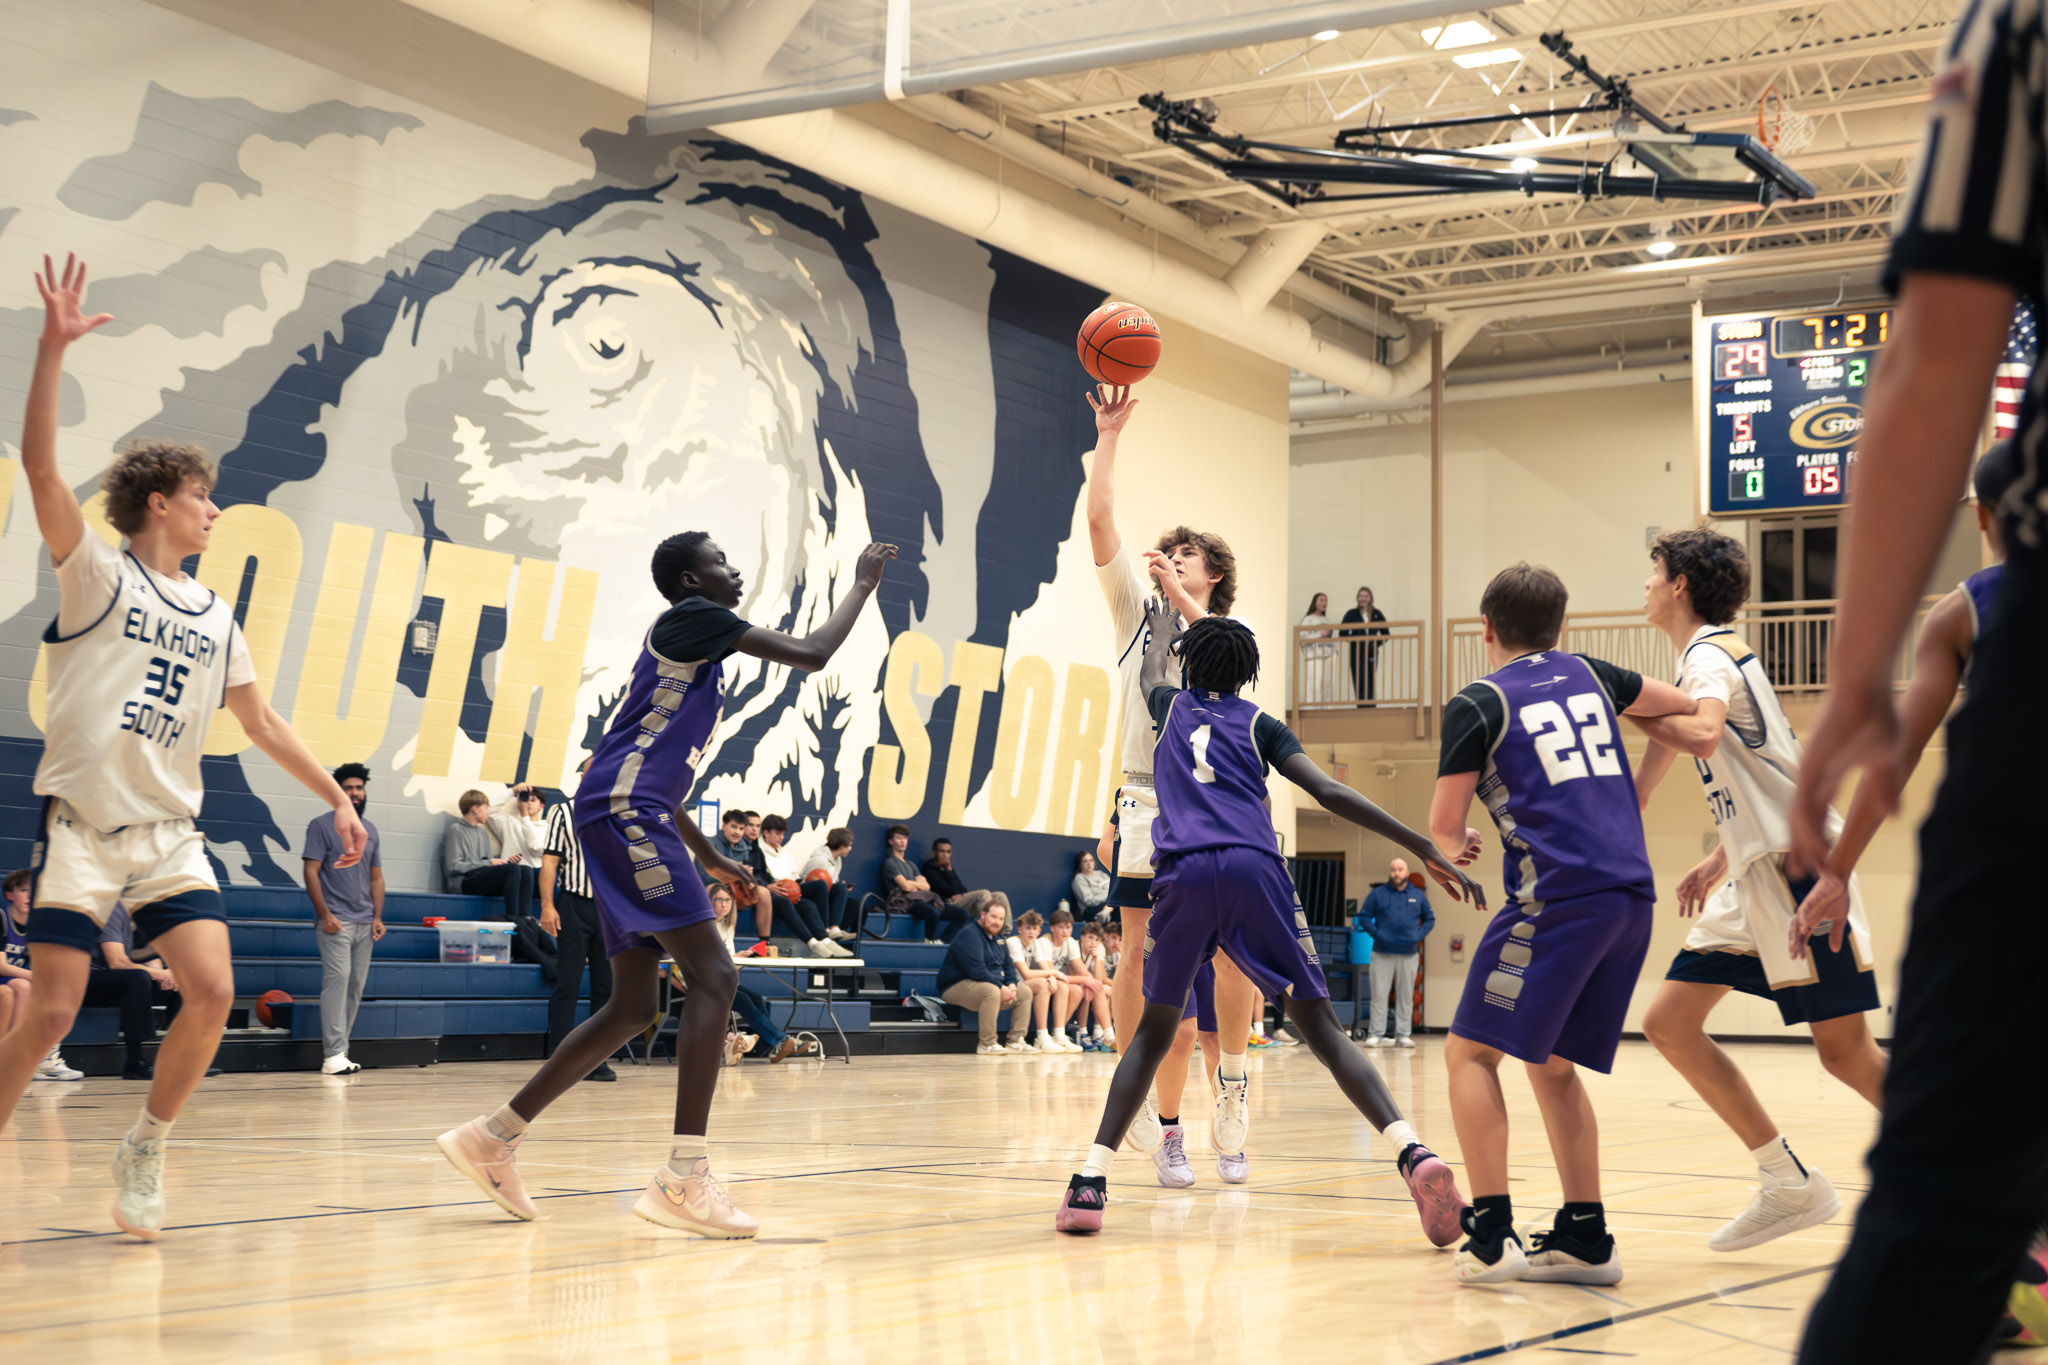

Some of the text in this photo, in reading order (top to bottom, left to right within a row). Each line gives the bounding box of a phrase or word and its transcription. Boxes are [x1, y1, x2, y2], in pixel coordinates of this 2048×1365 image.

[1803, 311, 1888, 350] 7:21
[1725, 342, 1767, 378] 29
[1802, 366, 1844, 381] PERIOD
[1847, 358, 1866, 387] 2
[1734, 379, 1773, 395] BONUS
[1716, 399, 1772, 416] TIMEOUTS
[1734, 414, 1752, 441] 5
[1828, 417, 1865, 434] STOR
[1729, 440, 1757, 455] LEFT
[1797, 452, 1839, 468] PLAYER
[1729, 457, 1765, 471] FOULS
[1745, 470, 1764, 498] 0
[1803, 465, 1840, 495] 05
[144, 656, 191, 706] 35
[868, 630, 1122, 837] STOR
[1519, 692, 1622, 787] 22
[1189, 724, 1217, 784] 1
